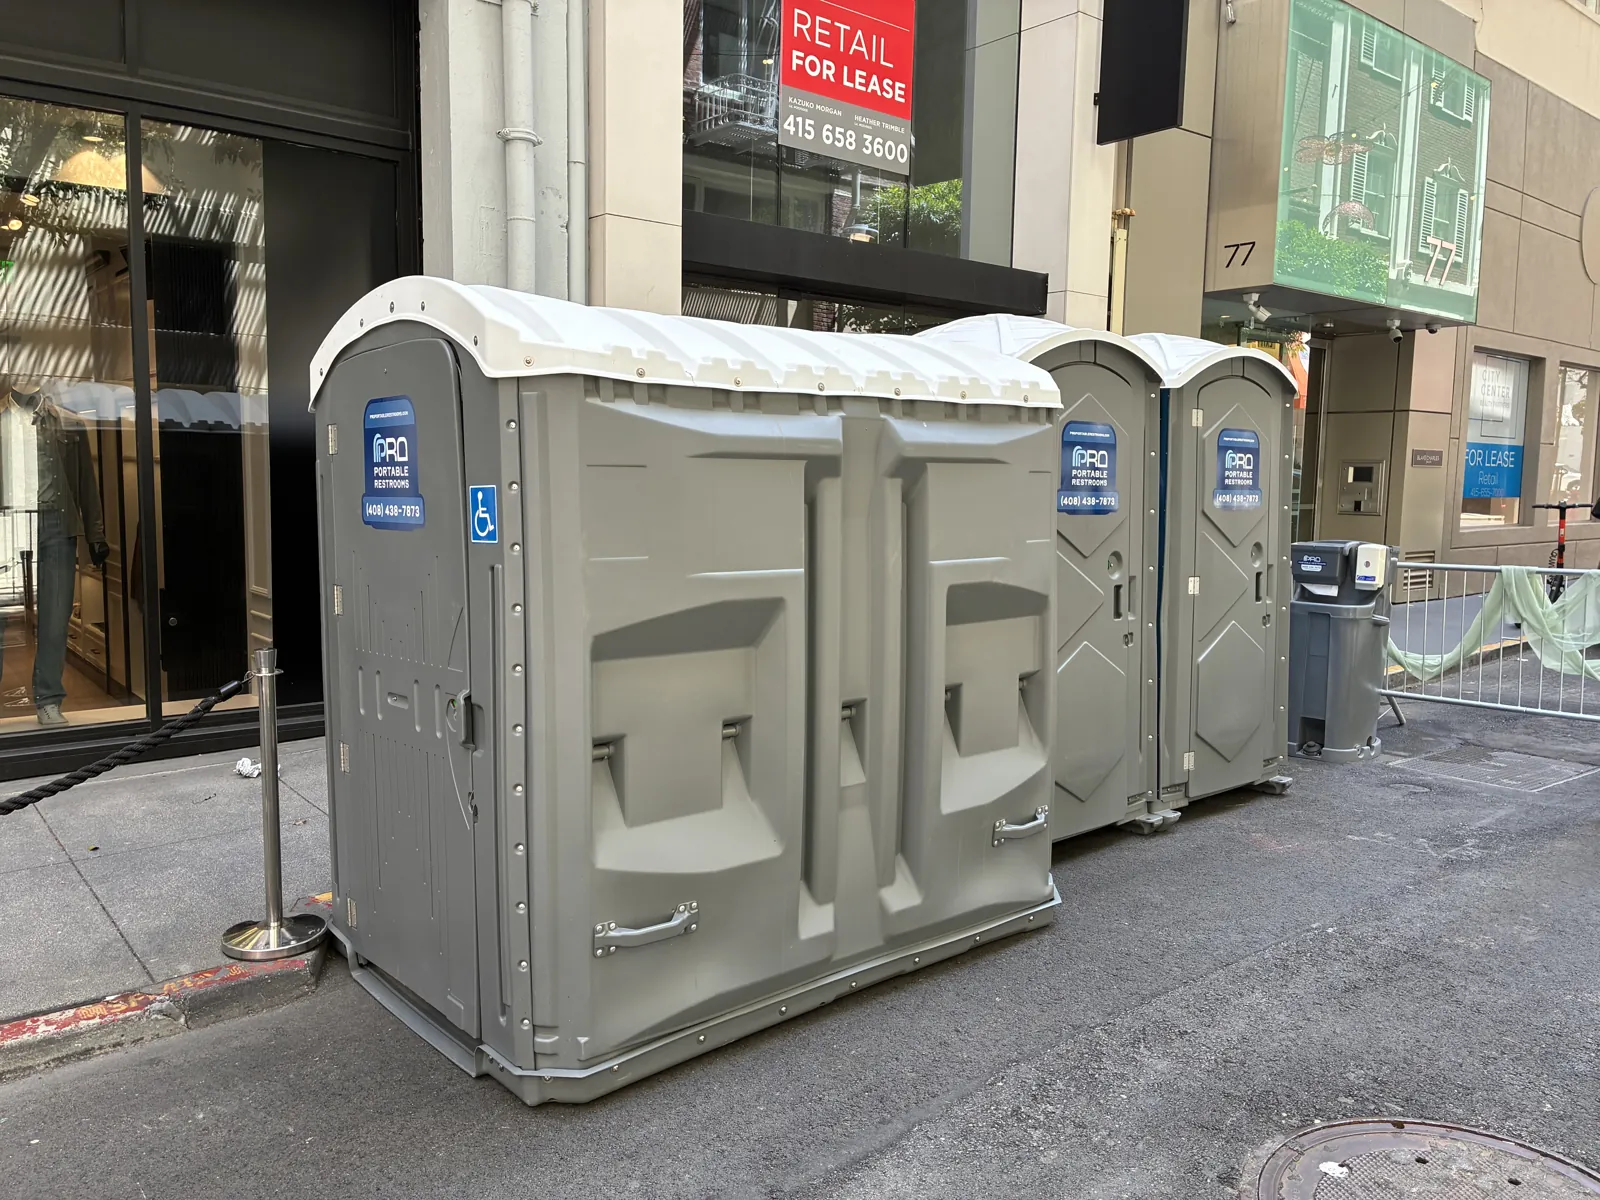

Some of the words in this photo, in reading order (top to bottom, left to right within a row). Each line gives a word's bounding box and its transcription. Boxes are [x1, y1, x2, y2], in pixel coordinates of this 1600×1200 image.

[793, 8, 894, 68] RETAIL
[791, 50, 836, 82] FOR
[843, 65, 906, 103] LEASE
[788, 96, 814, 109] KAZUKO
[816, 104, 842, 117] MORGAN
[854, 115, 880, 127] HEATHER
[881, 122, 905, 134] TRIMBLE
[783, 114, 815, 140] 415
[822, 124, 856, 150] 658
[862, 134, 908, 163] 3600
[1224, 241, 1256, 268] 77
[1424, 236, 1457, 285] 77
[1481, 369, 1501, 383] CITY
[1480, 383, 1510, 399] CENTER
[373, 433, 409, 463] PRO
[1072, 445, 1108, 468] PRO
[1225, 449, 1254, 470] PRO
[1485, 450, 1515, 468] LEASE
[373, 466, 409, 477] PORTABLE
[1071, 469, 1108, 478] PORTABLE
[1224, 470, 1253, 478] PORTABLE
[1478, 470, 1499, 486] Retail
[374, 479, 410, 489] RESTROOMS
[1071, 478, 1108, 487] RESTROOMS
[1224, 478, 1253, 486] RESTROOMS
[1060, 495, 1081, 507] (408)
[1082, 496, 1115, 506] 438-7873
[1216, 493, 1232, 503] (408)
[365, 502, 384, 517] (408)
[385, 504, 420, 518] 438-7873
